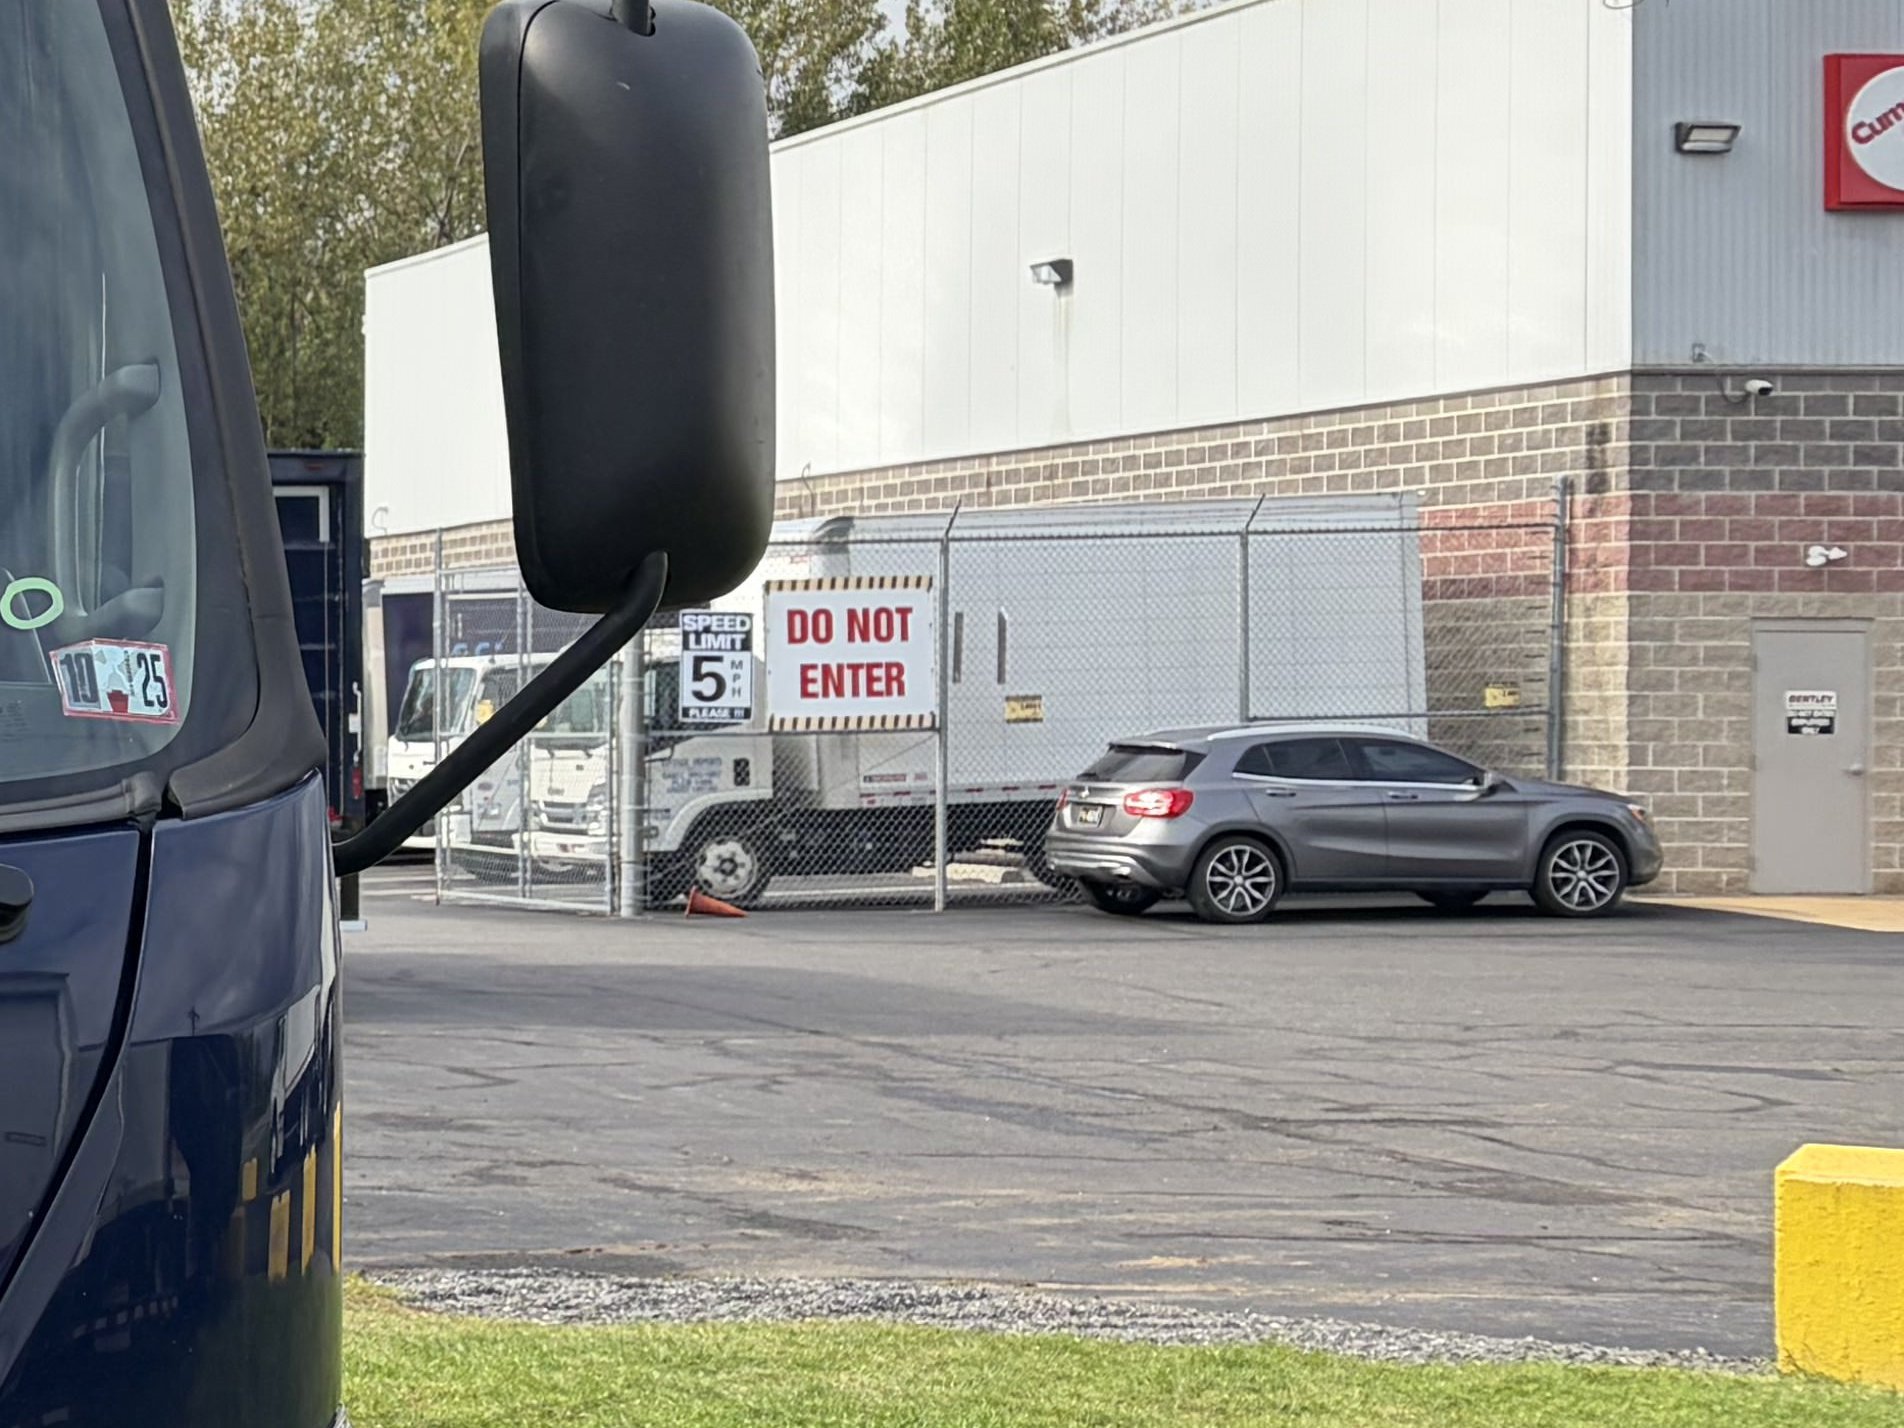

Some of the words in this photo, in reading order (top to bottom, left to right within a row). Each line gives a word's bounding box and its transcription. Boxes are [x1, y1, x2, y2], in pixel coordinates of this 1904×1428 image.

[683, 614, 751, 633] SPEED
[689, 633, 746, 651] LIMIT
[786, 608, 834, 645] DO
[846, 606, 913, 643] NOT
[136, 652, 169, 709] 25
[691, 655, 727, 703] 5
[799, 661, 906, 699] ENTER
[688, 707, 731, 718] PLEASE
